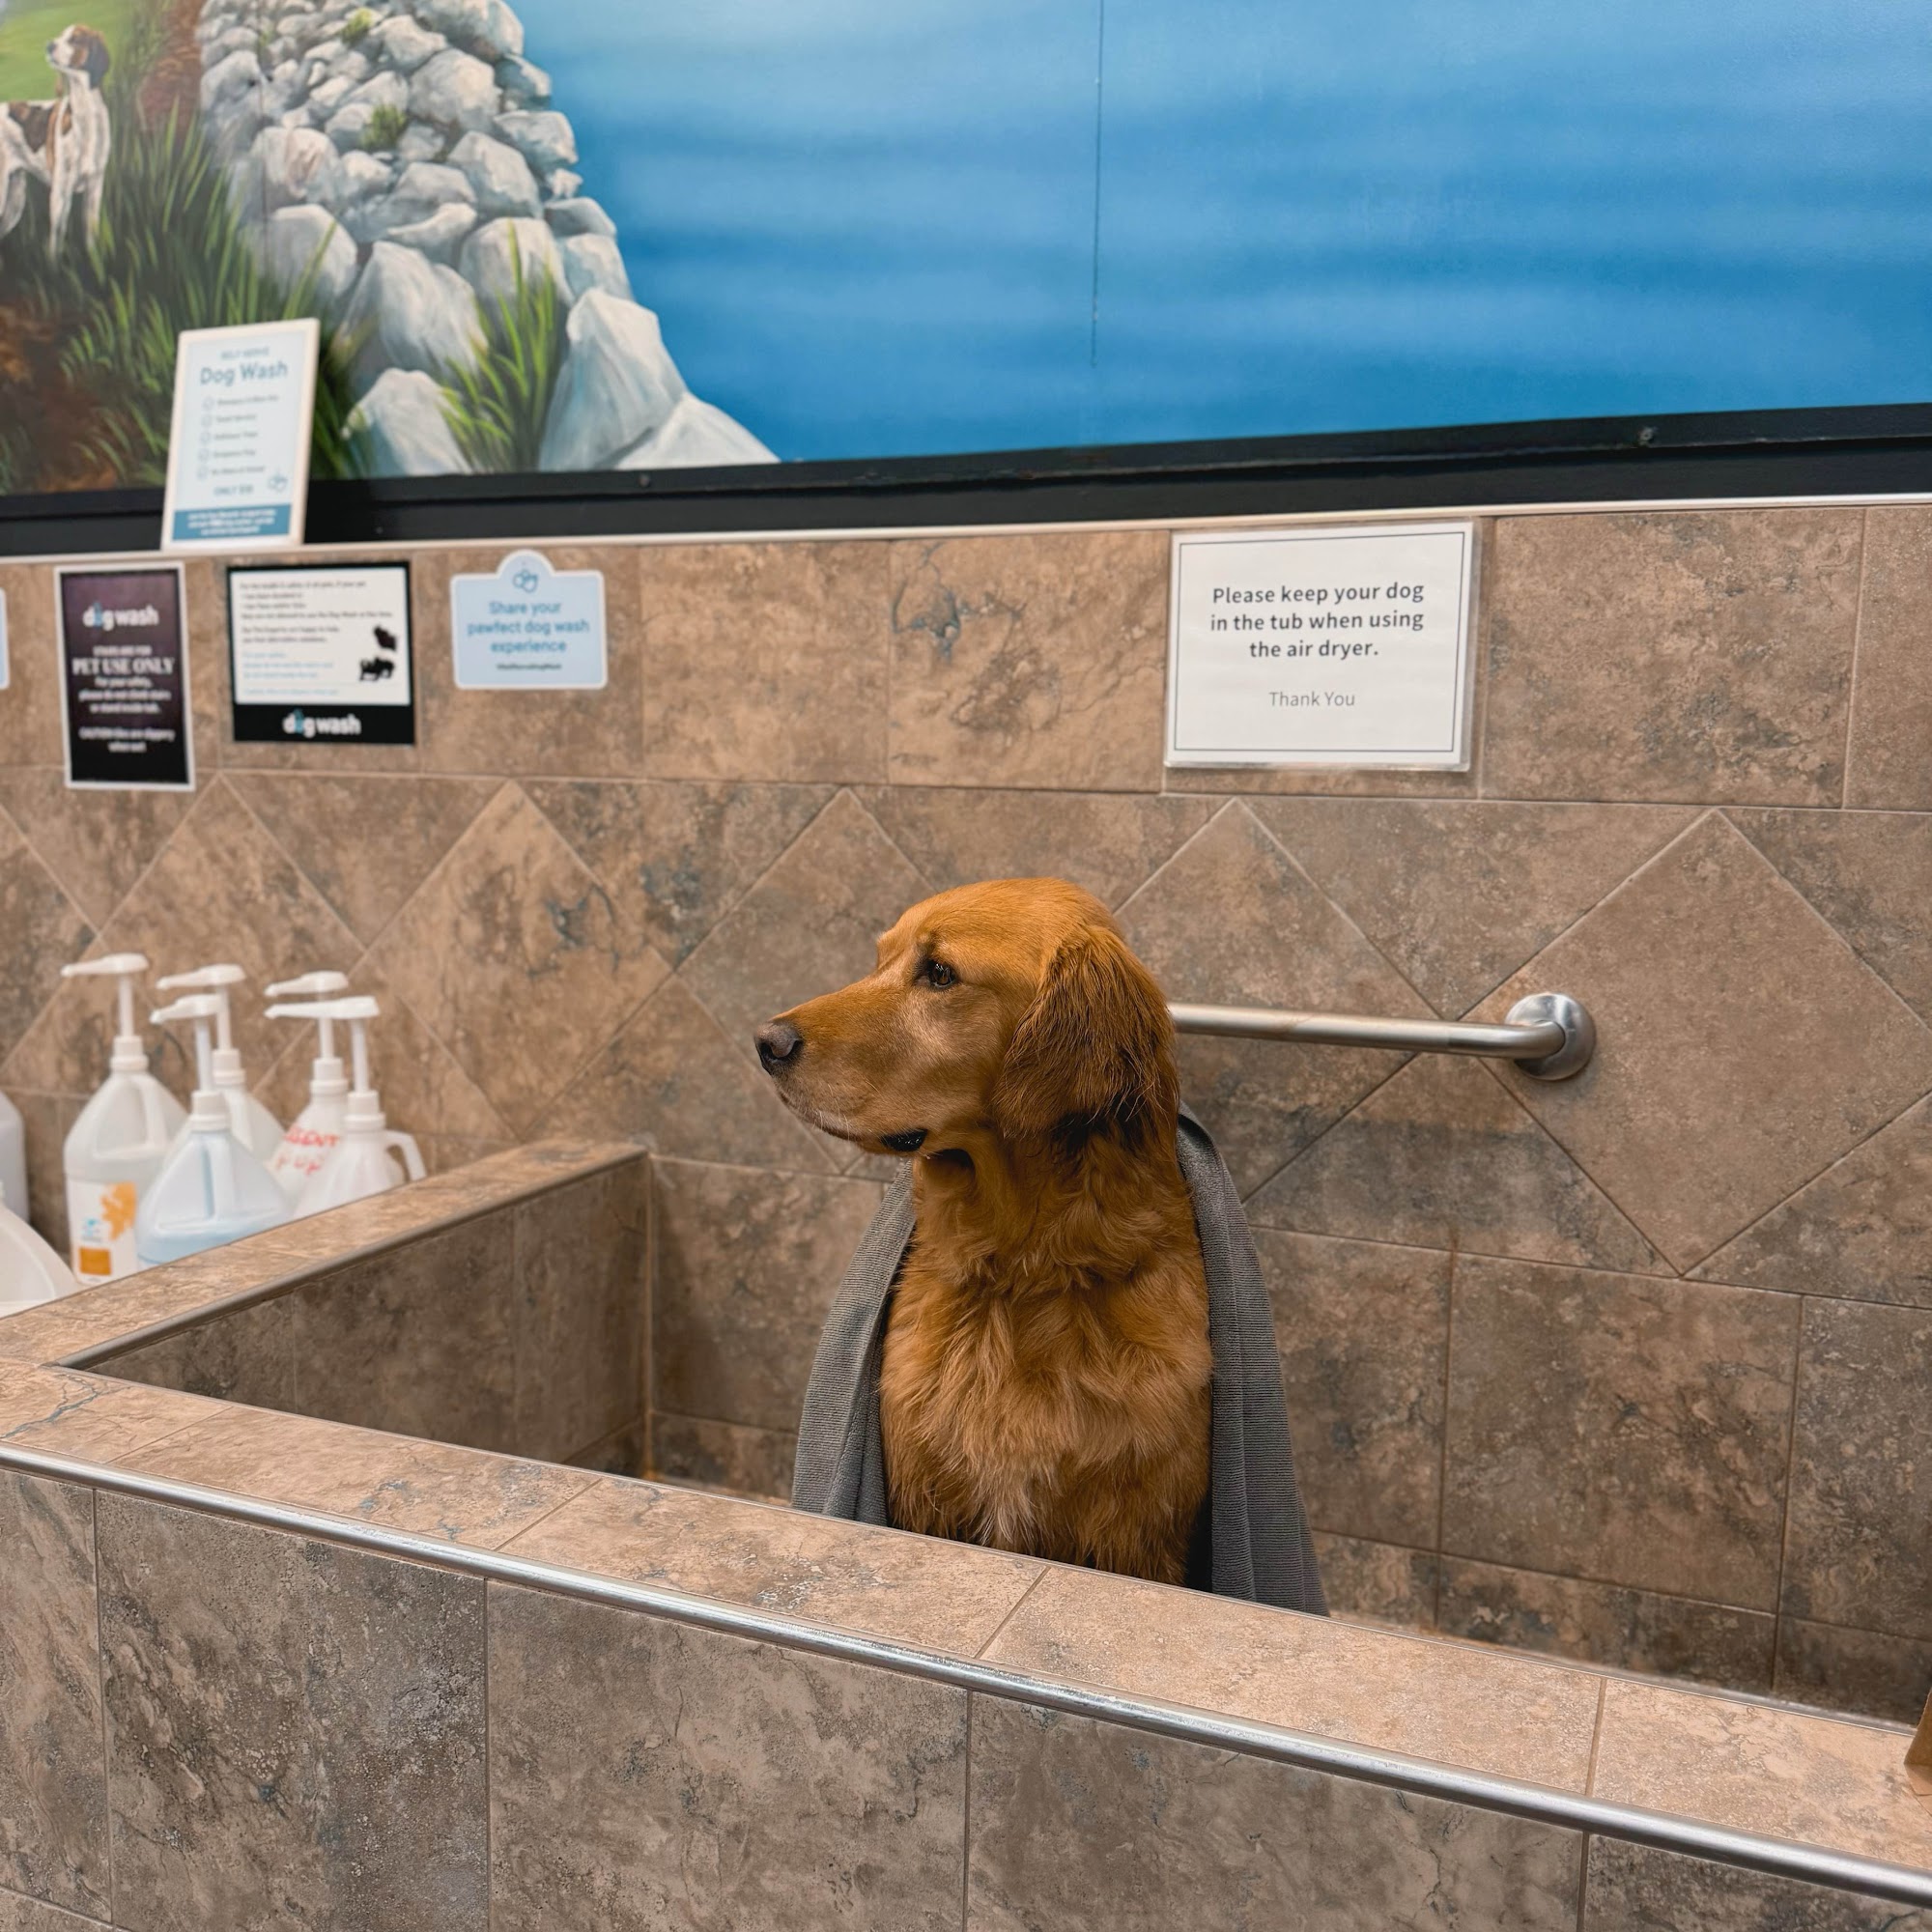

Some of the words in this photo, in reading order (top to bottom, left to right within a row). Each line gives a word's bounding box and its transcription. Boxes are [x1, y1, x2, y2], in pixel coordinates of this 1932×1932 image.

[200, 366, 236, 387] Dog
[239, 359, 289, 381] Wash
[1212, 587, 1275, 604] Please
[1281, 584, 1328, 606] keep
[1334, 585, 1381, 605] your
[1385, 582, 1425, 603] dog
[82, 602, 115, 632] dog
[115, 604, 159, 627] wash
[489, 601, 527, 615] Share
[530, 601, 562, 616] your
[467, 620, 522, 638] pawfect
[524, 619, 552, 637] dog
[554, 617, 591, 634] wash
[1210, 613, 1228, 631] in
[1234, 613, 1264, 630] the
[1270, 612, 1303, 630] tub
[1309, 611, 1363, 629] when
[1369, 610, 1425, 632] using
[490, 639, 567, 655] experience
[1249, 640, 1281, 658] the
[1287, 639, 1314, 658] air
[1318, 639, 1379, 661] dryer.
[71, 657, 99, 675] PET
[101, 657, 130, 675] USE
[132, 657, 175, 675] ONLY
[1268, 691, 1321, 707] Thank
[1324, 691, 1356, 707] You
[282, 708, 316, 739] dog
[316, 713, 362, 735] wash
